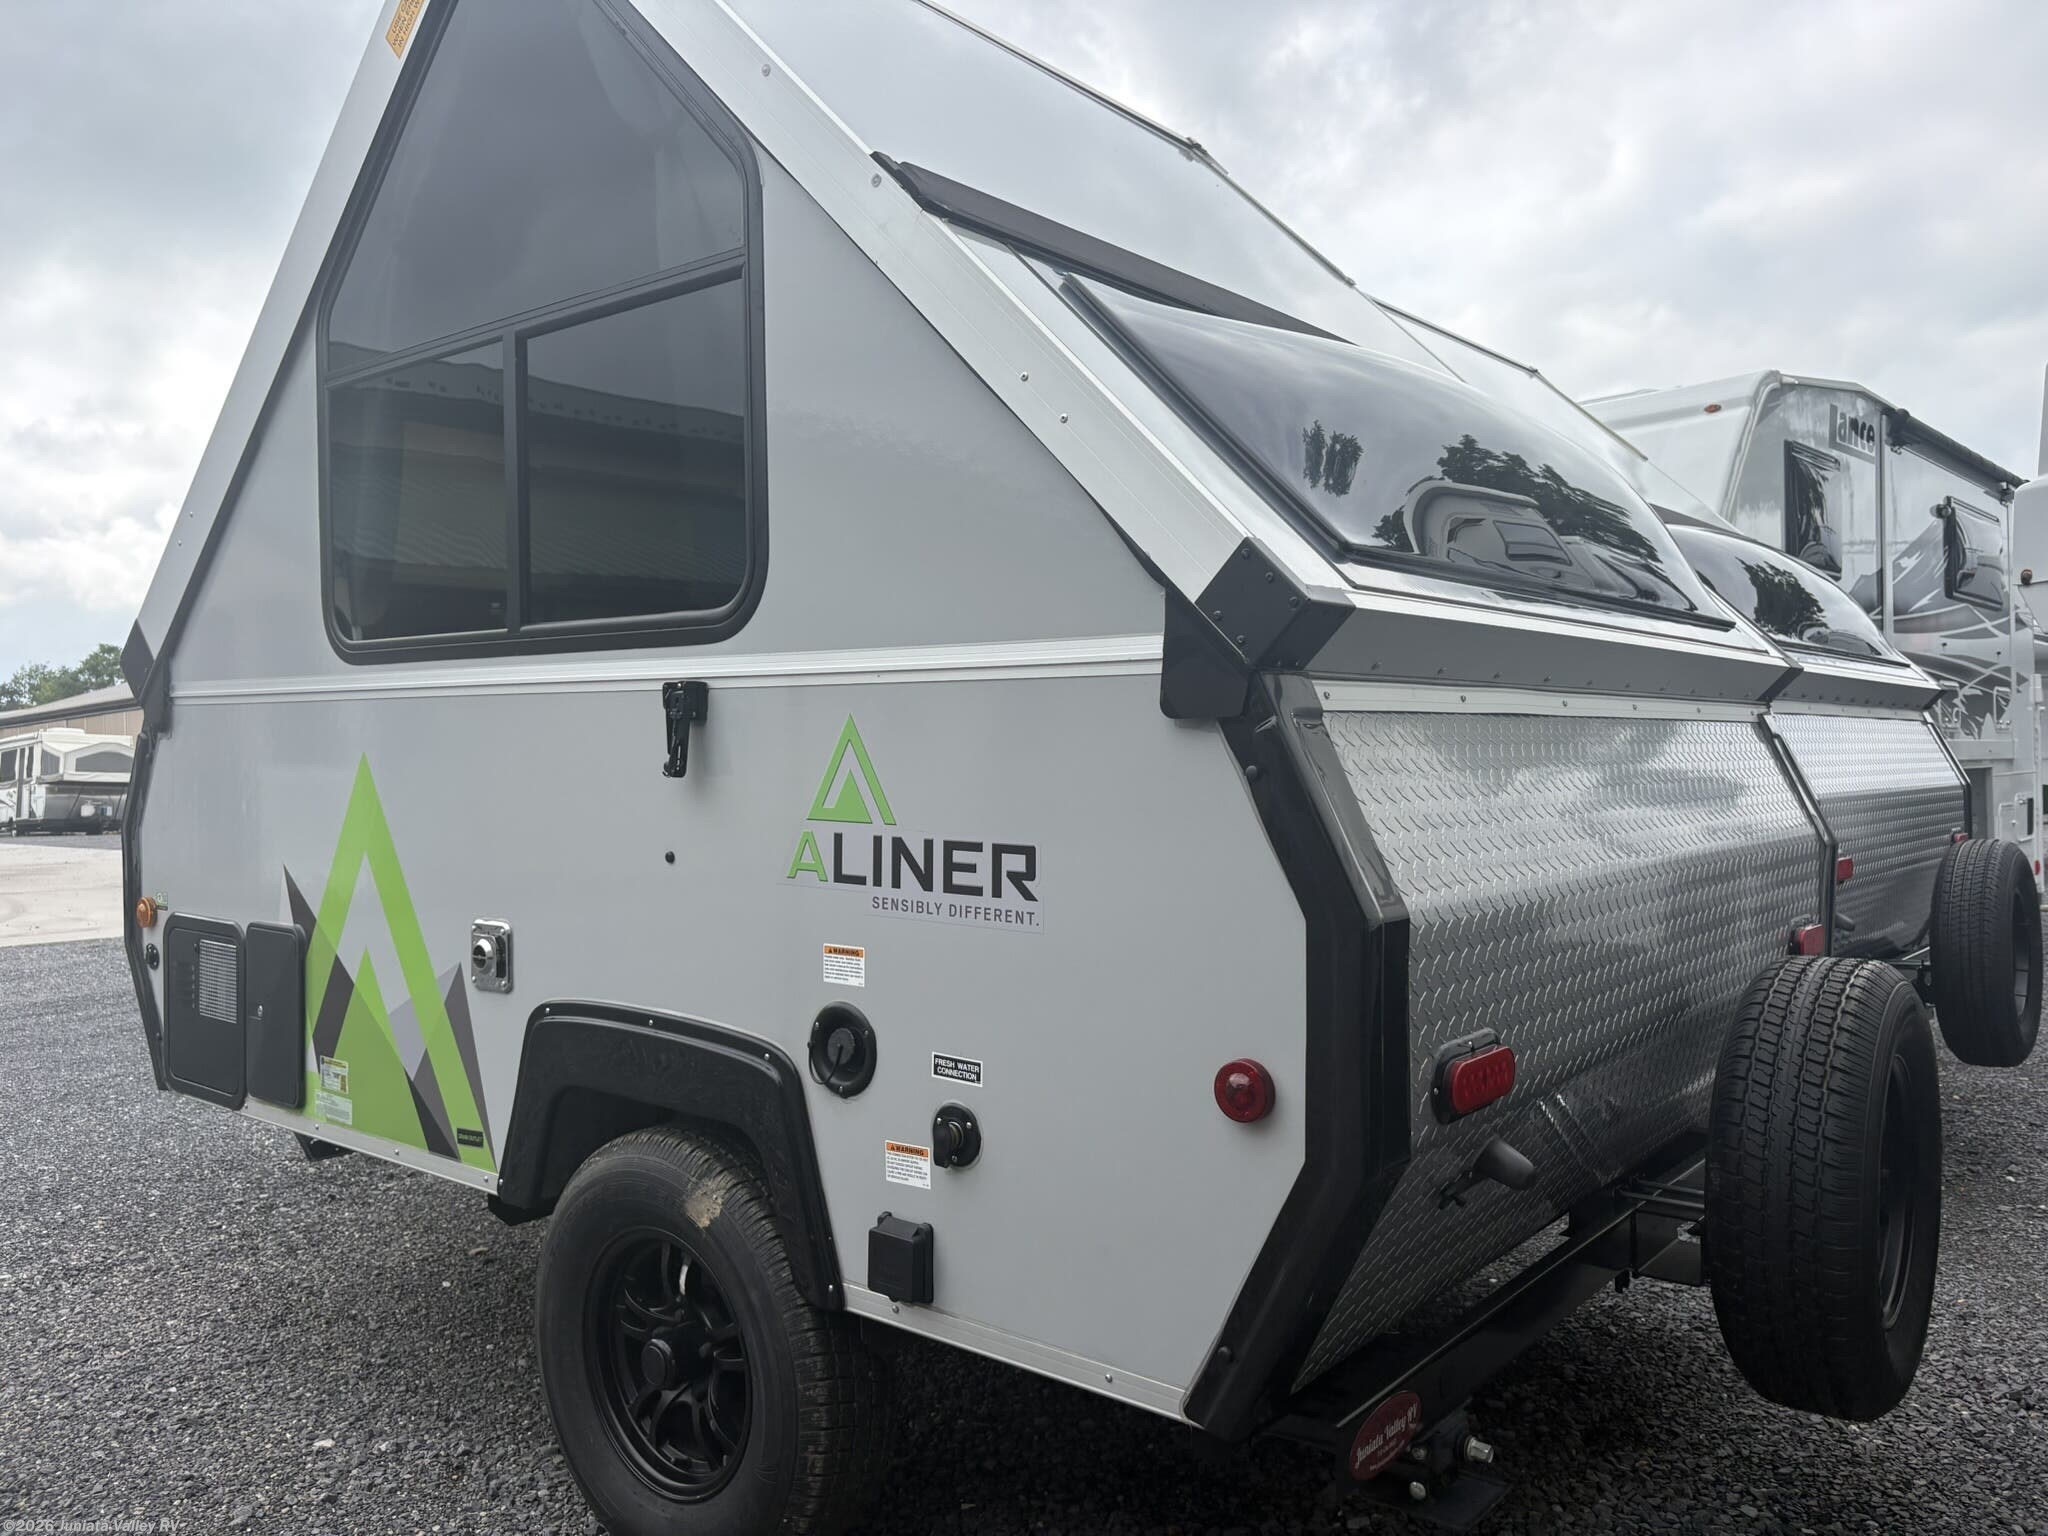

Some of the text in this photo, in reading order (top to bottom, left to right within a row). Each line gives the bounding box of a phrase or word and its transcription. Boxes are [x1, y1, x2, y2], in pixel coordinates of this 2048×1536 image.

[1829, 403, 1876, 459] Lance
[787, 830, 1039, 902] ALINER
[872, 896, 1040, 926] SENSIBLY DIFFERENT.
[935, 1058, 980, 1073] FRESH WATER
[937, 1066, 977, 1081] CONNECTION
[895, 1145, 924, 1156] WARNING
